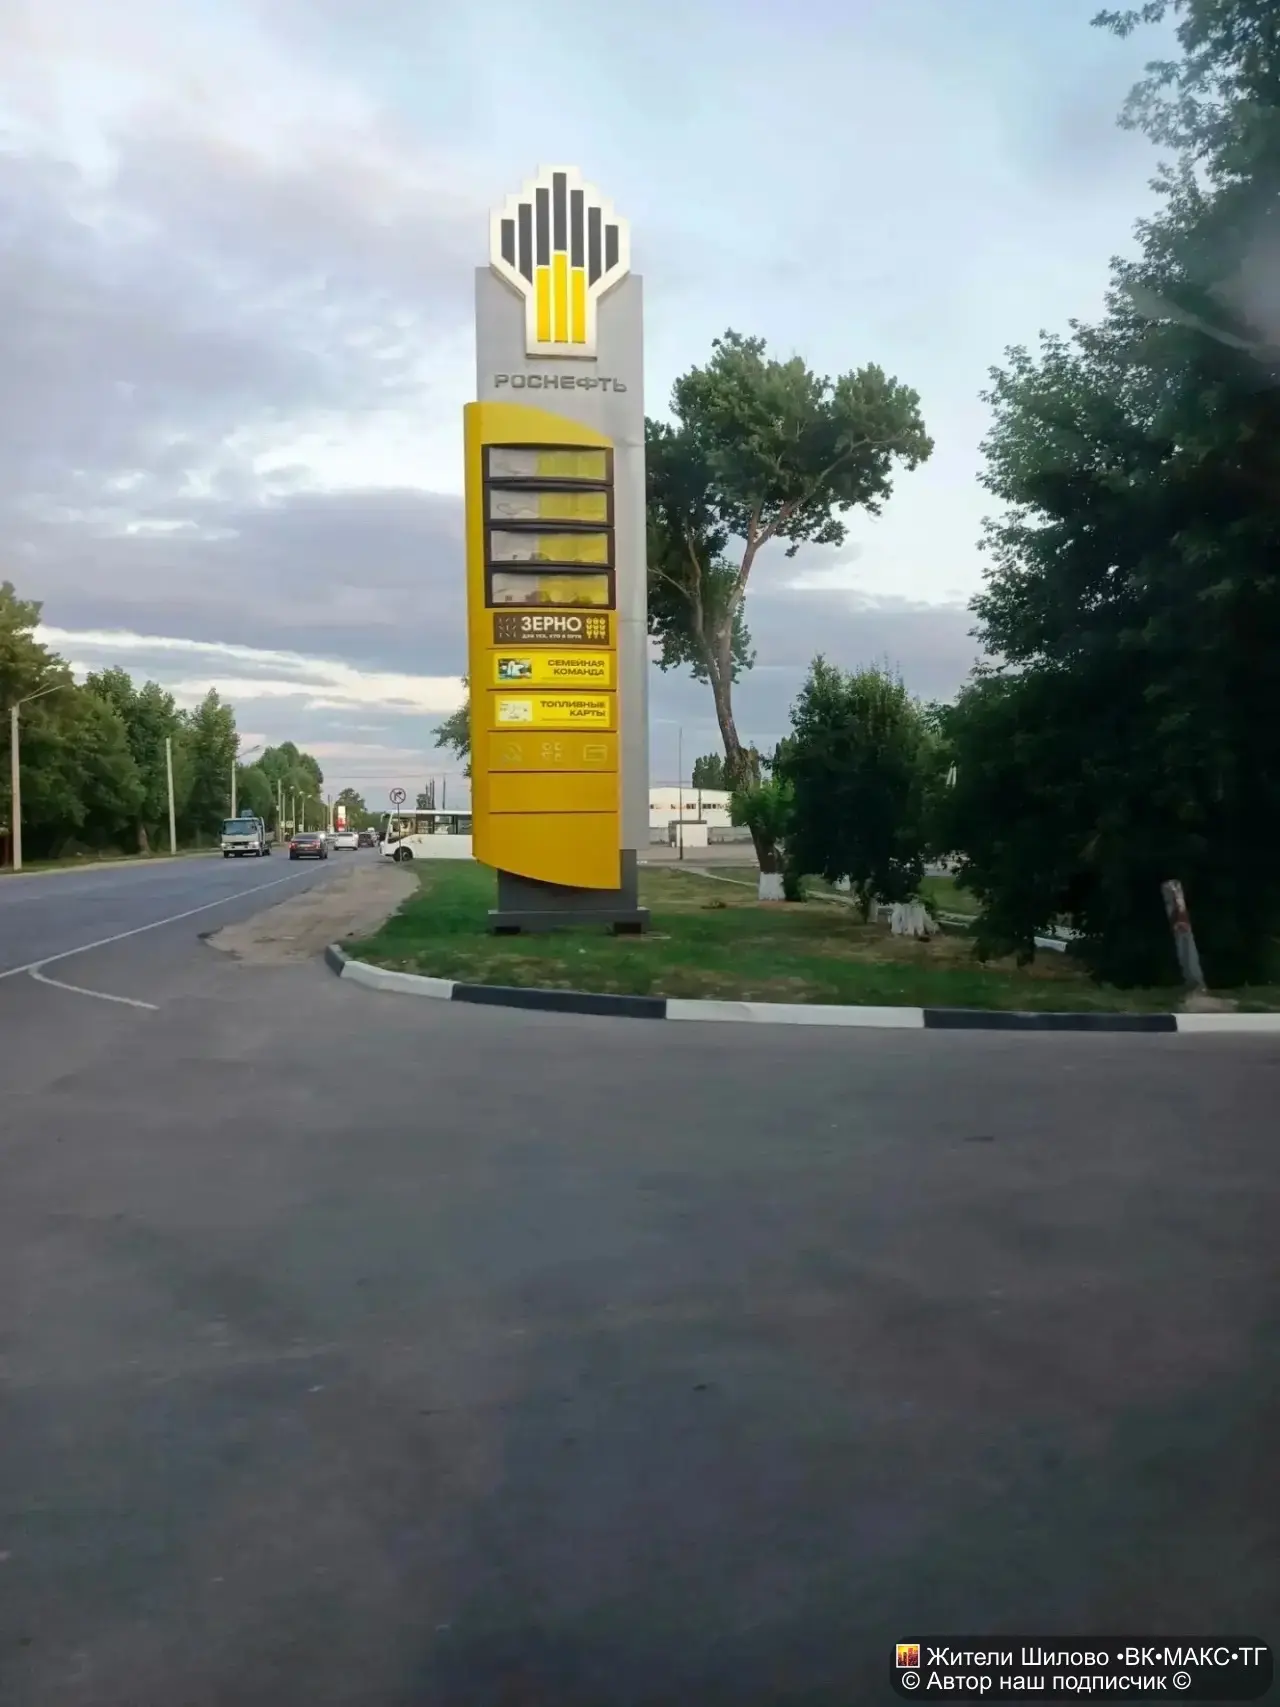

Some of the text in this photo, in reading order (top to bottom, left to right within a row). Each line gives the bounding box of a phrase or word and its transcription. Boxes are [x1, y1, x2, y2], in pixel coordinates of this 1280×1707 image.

[494, 374, 627, 392] РОСНЕФТЬ
[521, 616, 582, 631] ЗЕРНО
[547, 658, 605, 667] СЕМЕЙНАЯ
[553, 668, 605, 676] КОМАНДА
[540, 700, 606, 708] ТОПЛИВНЫЕ
[569, 709, 606, 717] КАРТЫ
